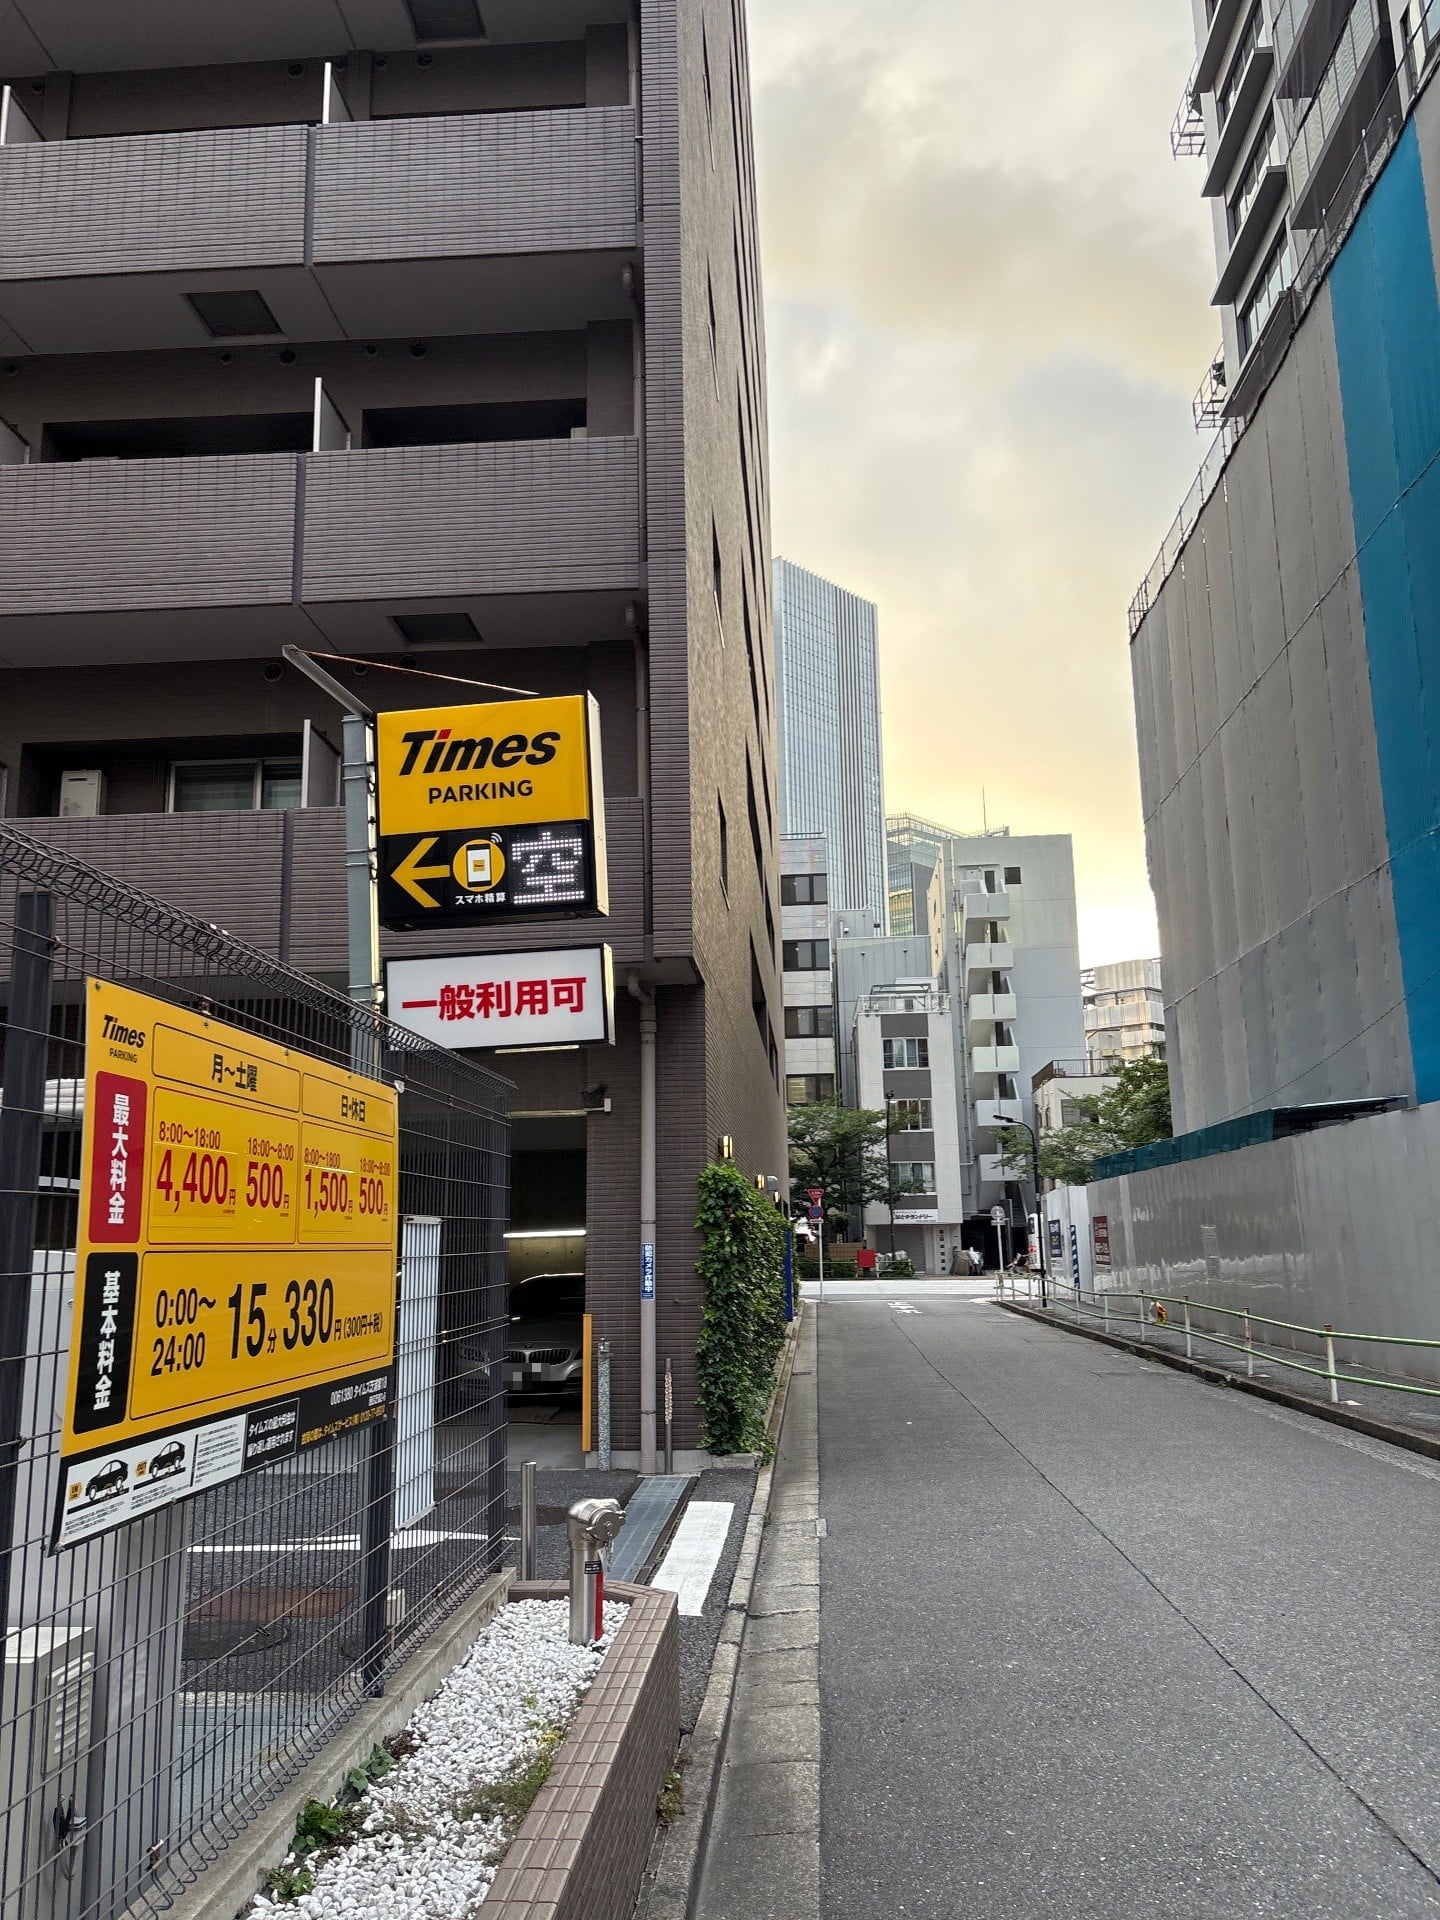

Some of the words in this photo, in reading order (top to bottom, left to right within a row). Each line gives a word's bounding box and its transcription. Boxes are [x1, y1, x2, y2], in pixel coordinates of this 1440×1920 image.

[399, 728, 560, 776] Times
[428, 779, 533, 804] PARKING
[512, 832, 585, 904] 空
[455, 891, 506, 905] スマホ精算
[402, 977, 587, 1021] 一般利用可
[101, 1014, 146, 1049] Times
[109, 1048, 138, 1064] PARKING
[107, 1094, 130, 1225] 最大料金
[92, 1271, 121, 1411] 基本料金
[150, 1332, 206, 1377] 24:00
